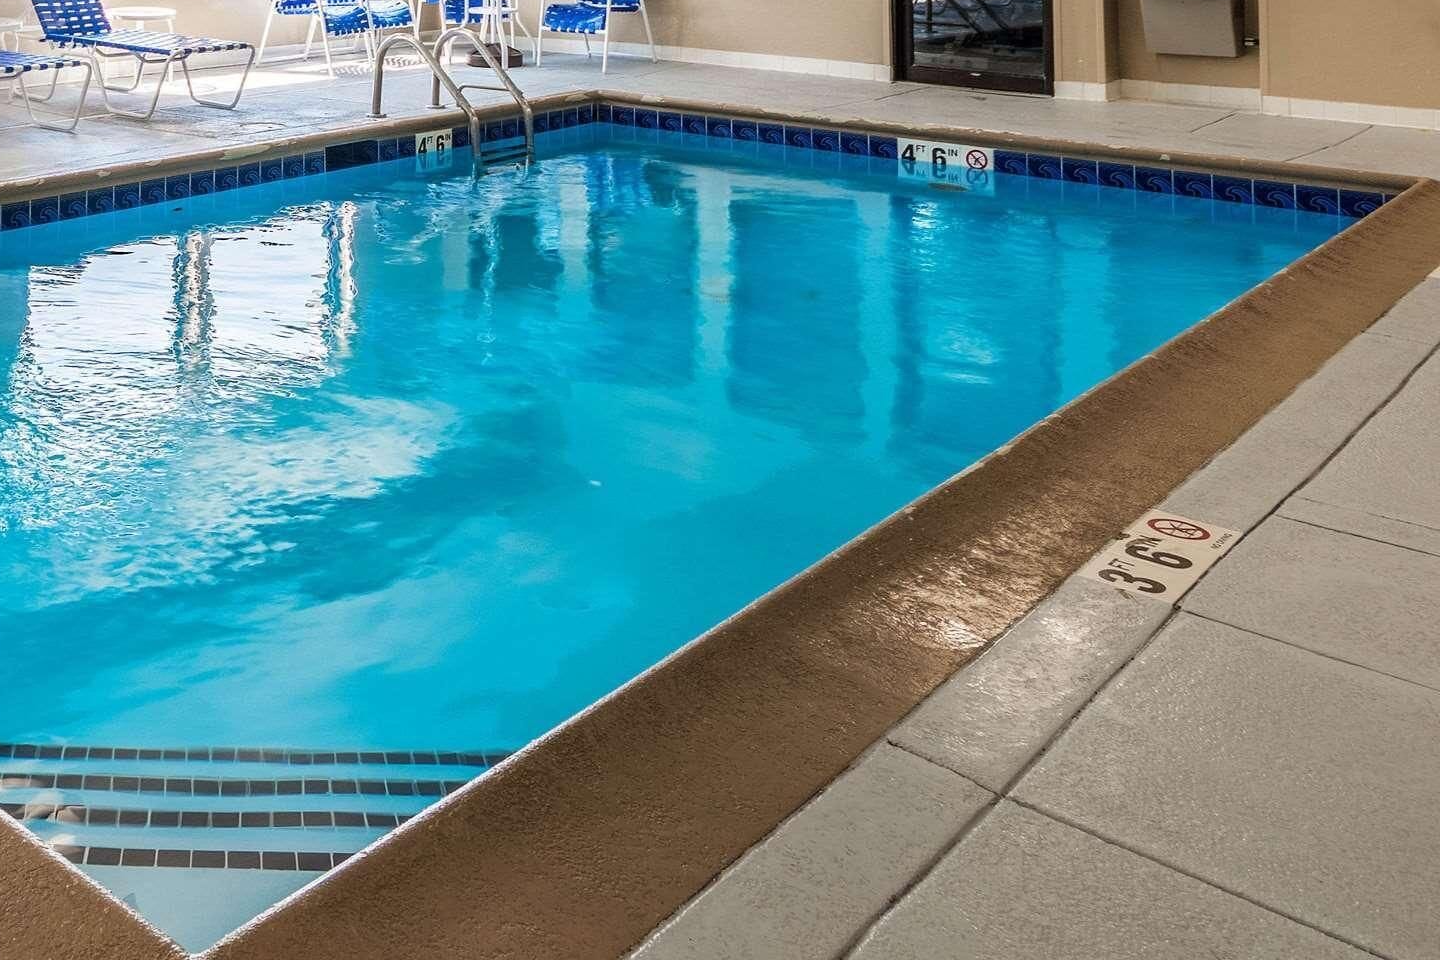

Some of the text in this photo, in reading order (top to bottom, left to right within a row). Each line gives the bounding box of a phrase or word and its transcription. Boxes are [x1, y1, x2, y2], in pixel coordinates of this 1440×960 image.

[418, 137, 427, 153] 4
[437, 135, 444, 152] 6
[901, 144, 958, 165] 4 FT 6 IN
[1125, 543, 1193, 569] 6
[1098, 569, 1166, 593] 3
